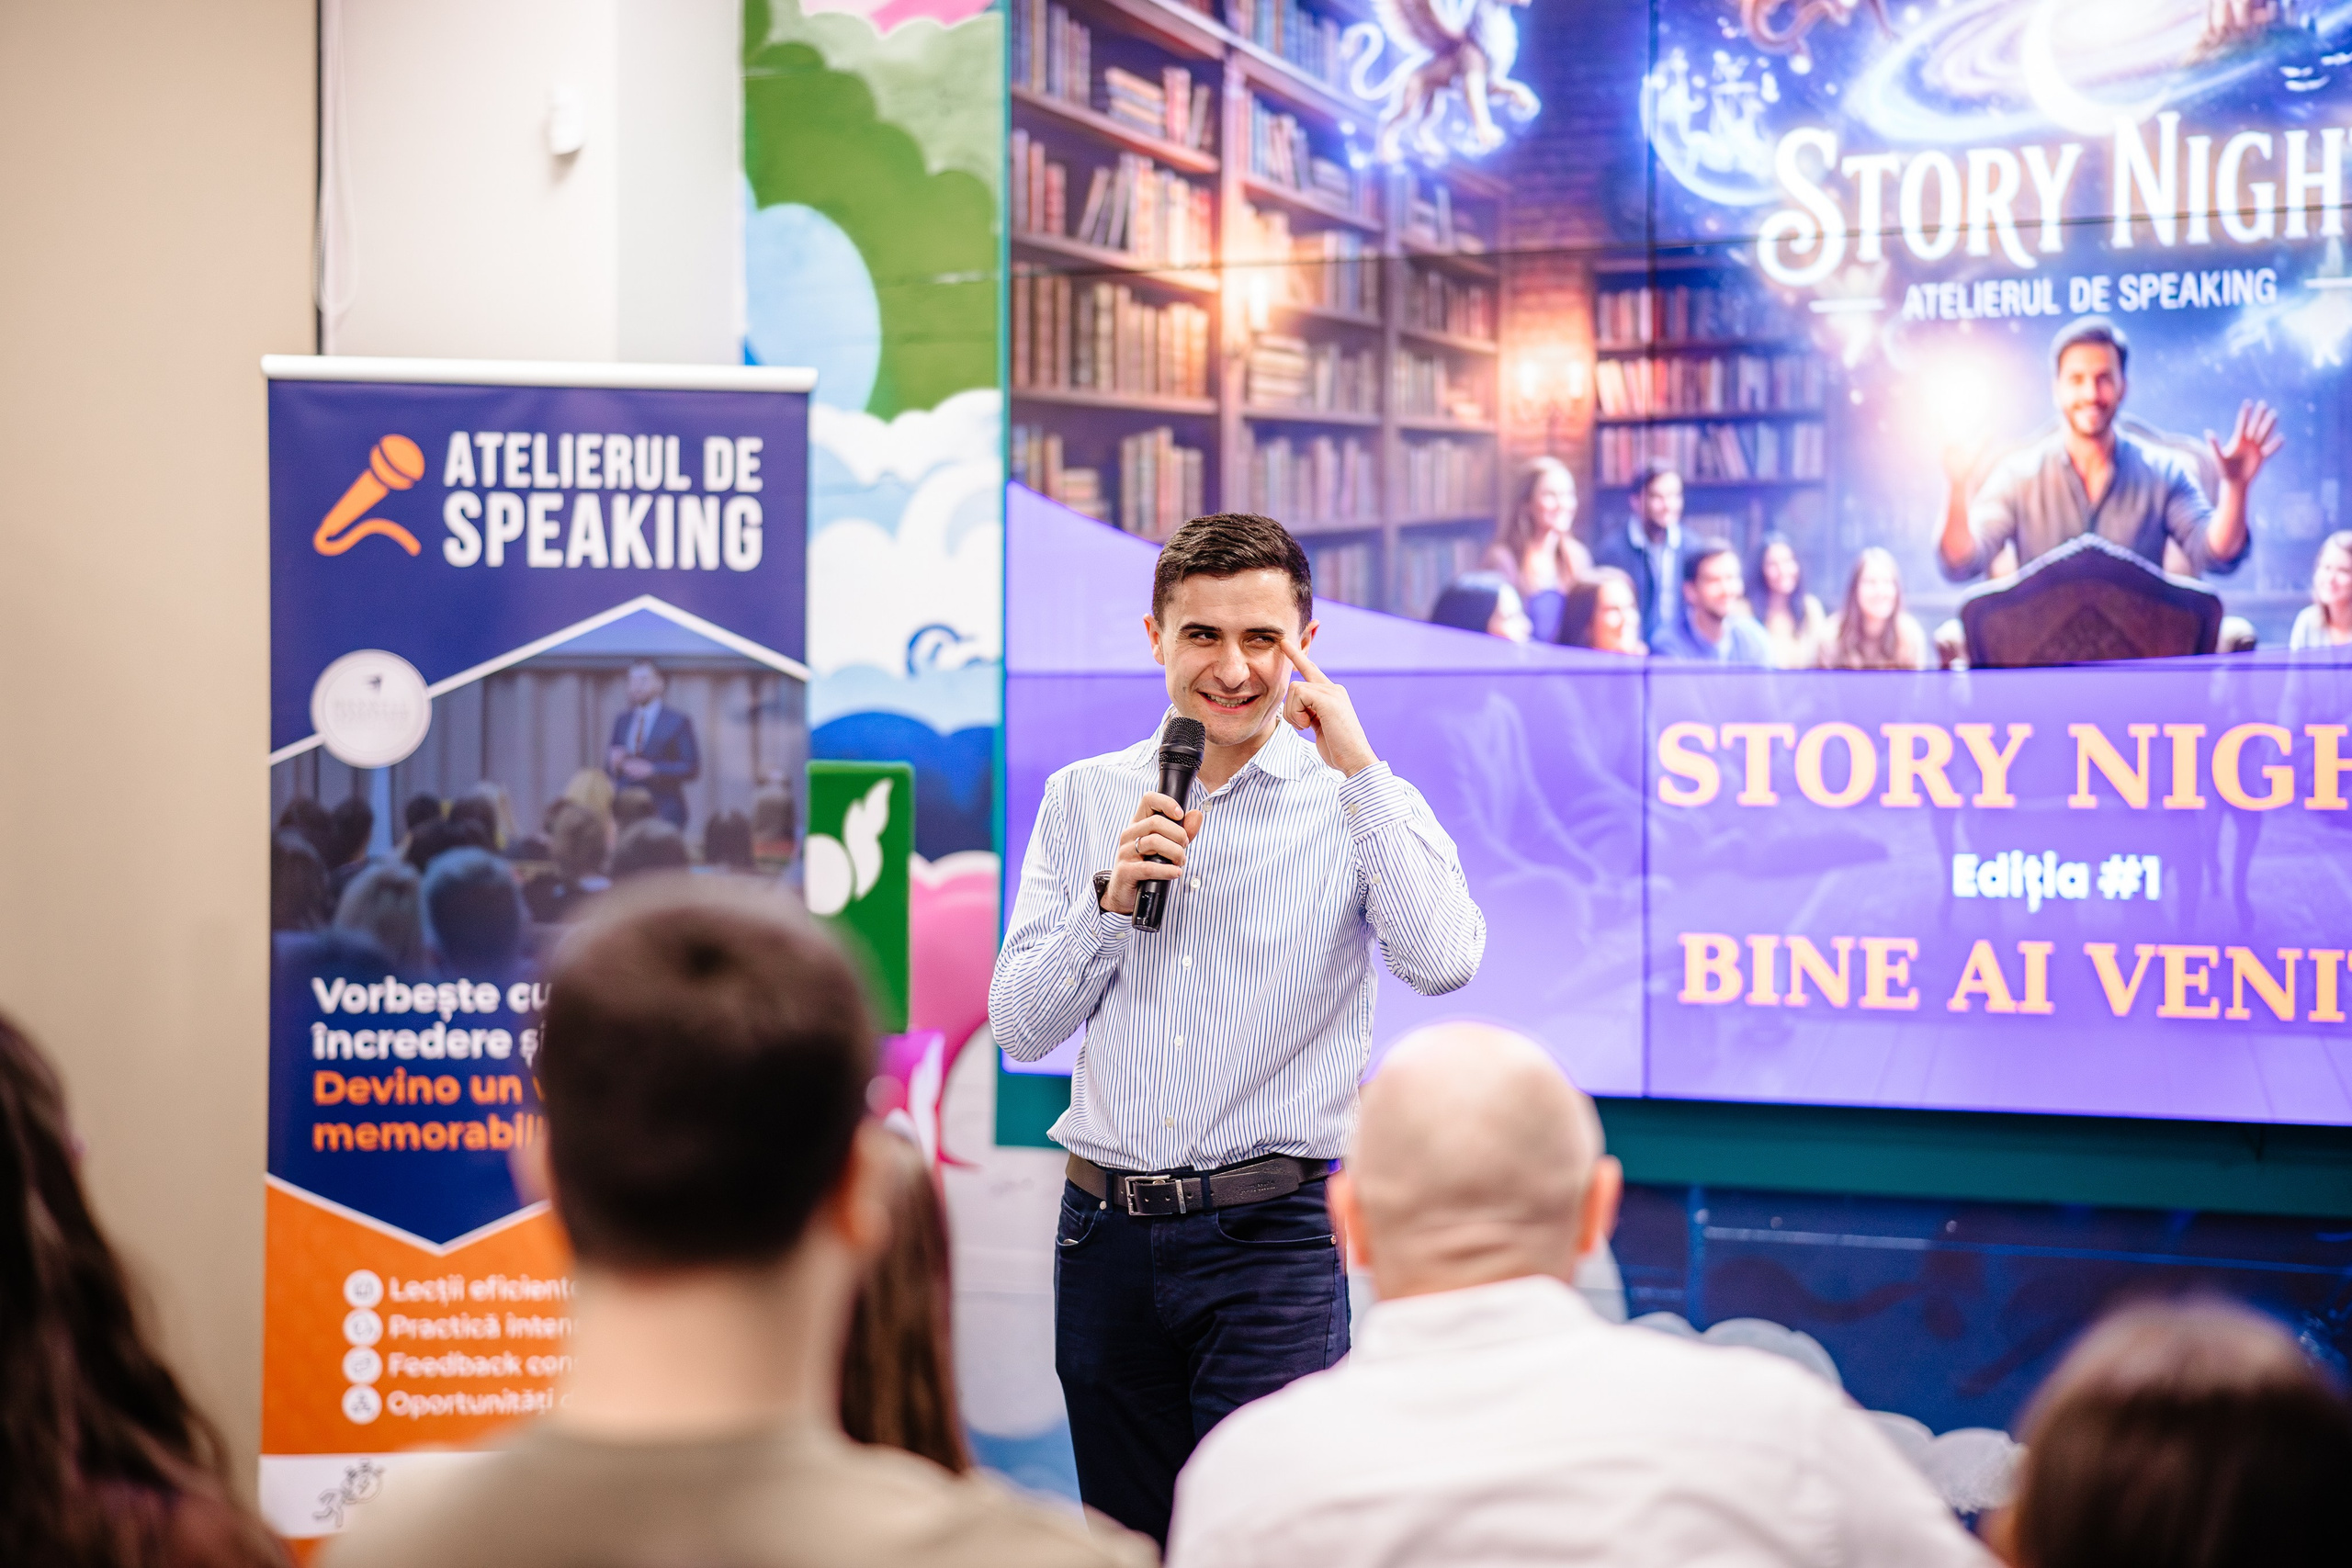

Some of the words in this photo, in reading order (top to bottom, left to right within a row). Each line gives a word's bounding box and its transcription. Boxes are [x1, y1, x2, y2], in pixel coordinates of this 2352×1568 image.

[1757, 127, 2083, 288] STORY
[2110, 111, 2352, 249] NIGH
[1901, 277, 2062, 321] ATELIERUL
[2069, 275, 2112, 314] DE
[2118, 268, 2278, 312] SPEAKING
[443, 431, 692, 491] ATELIERUL
[703, 436, 763, 492] DE
[442, 490, 763, 572] SPEAKING
[1657, 721, 2033, 808] STORY
[2097, 852, 2164, 900] #1
[506, 981, 553, 1014] cu
[1678, 931, 1920, 1010] BINE
[1946, 939, 2056, 1014] AI
[2083, 942, 2352, 1022] VENI
[311, 1021, 513, 1061] încredere
[313, 1066, 461, 1106] Devino
[469, 1074, 523, 1105] un
